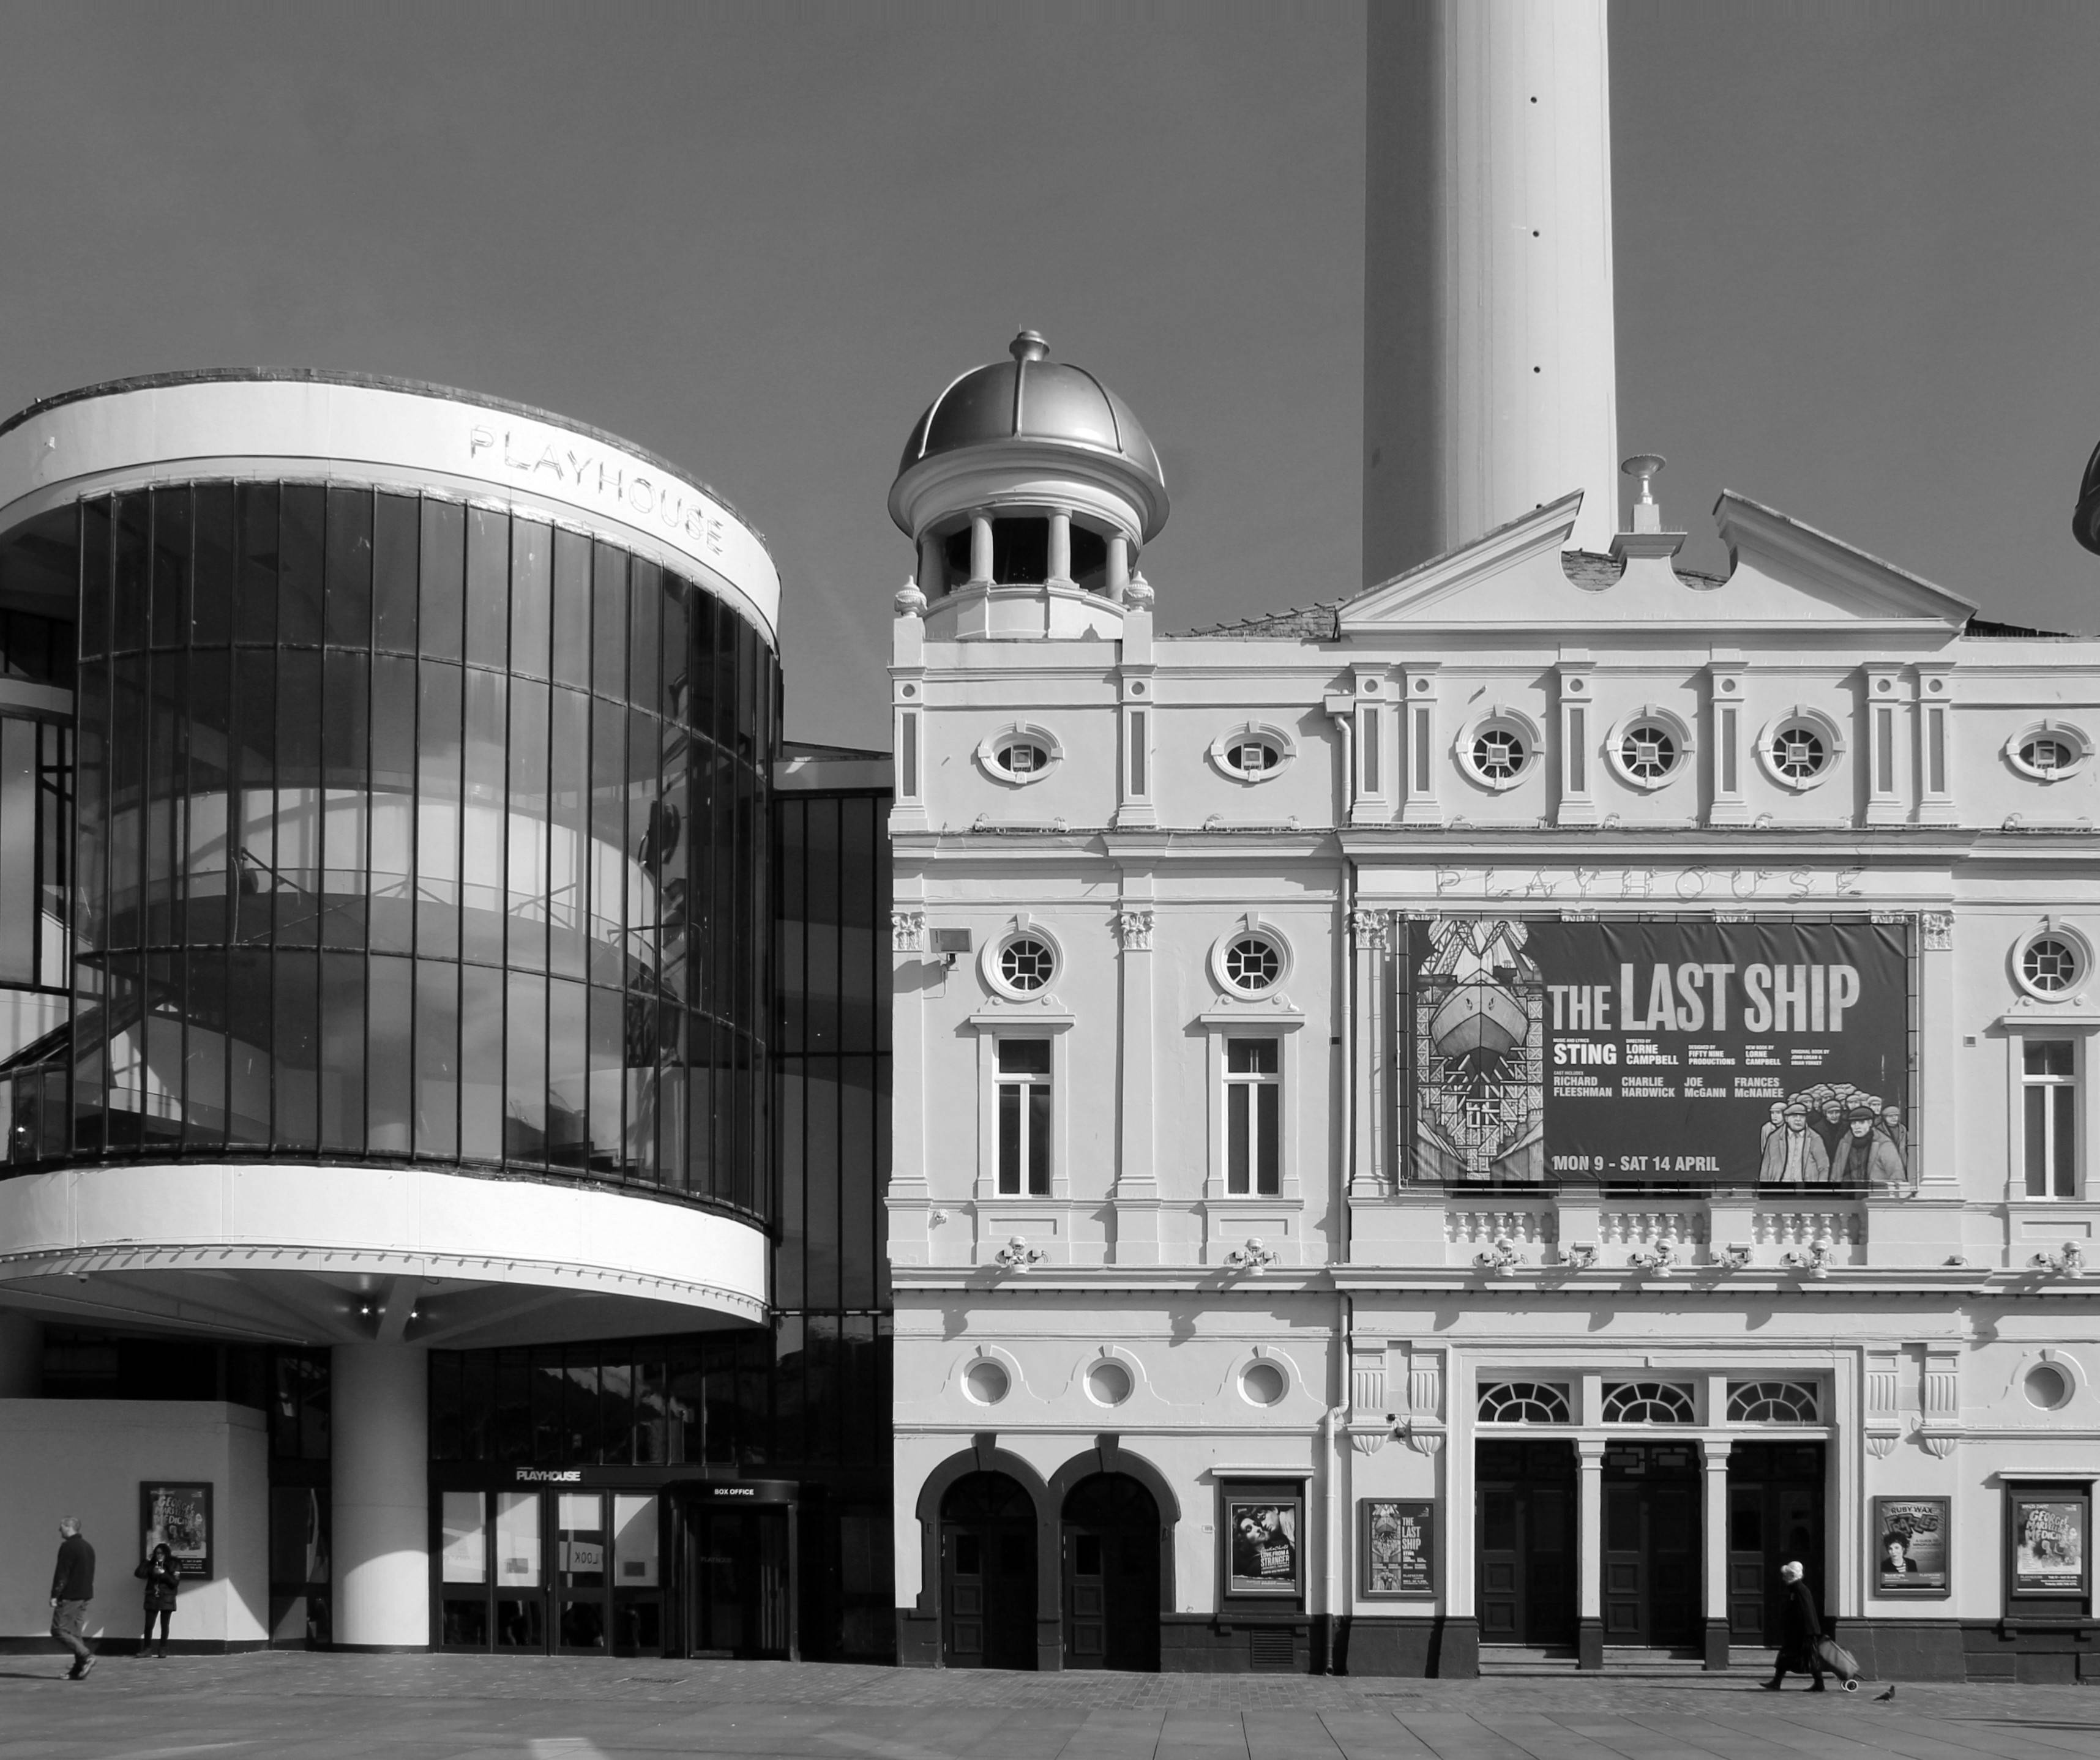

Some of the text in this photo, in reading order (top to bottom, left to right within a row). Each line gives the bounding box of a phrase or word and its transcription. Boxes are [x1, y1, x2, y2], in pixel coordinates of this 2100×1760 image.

[470, 424, 724, 556] PLAYHOUSE
[1435, 864, 1866, 904] PLAYHOUSE
[1547, 962, 1860, 1032] THE LAST SHIP
[1553, 1043, 1617, 1065] STING
[1626, 1044, 1658, 1054] LORNE
[1626, 1055, 1679, 1065] CAMPBELL
[1553, 1076, 1597, 1086] RICHARD
[1622, 1077, 1664, 1086] CHARLIE
[1684, 1077, 1703, 1086] JOE
[1735, 1078, 1780, 1087] FRANCES
[1553, 1087, 1612, 1097] FLEESHMAN
[1622, 1087, 1675, 1097] HARDWICK
[1684, 1088, 1726, 1097] McGANN
[1735, 1088, 1784, 1098] McNAMEE
[1553, 1155, 1589, 1170] MON
[1594, 1156, 1604, 1171] 9
[1620, 1156, 1648, 1171] SAT
[1653, 1156, 1670, 1171] 14
[1675, 1156, 1720, 1171] APRIL
[516, 1471, 581, 1481] PLAYHOUSE
[1402, 1517, 1414, 1526] THE
[1402, 1526, 1421, 1538] LAST
[1402, 1538, 1421, 1550] SHIP
[1261, 1555, 1290, 1567] STRANGER
